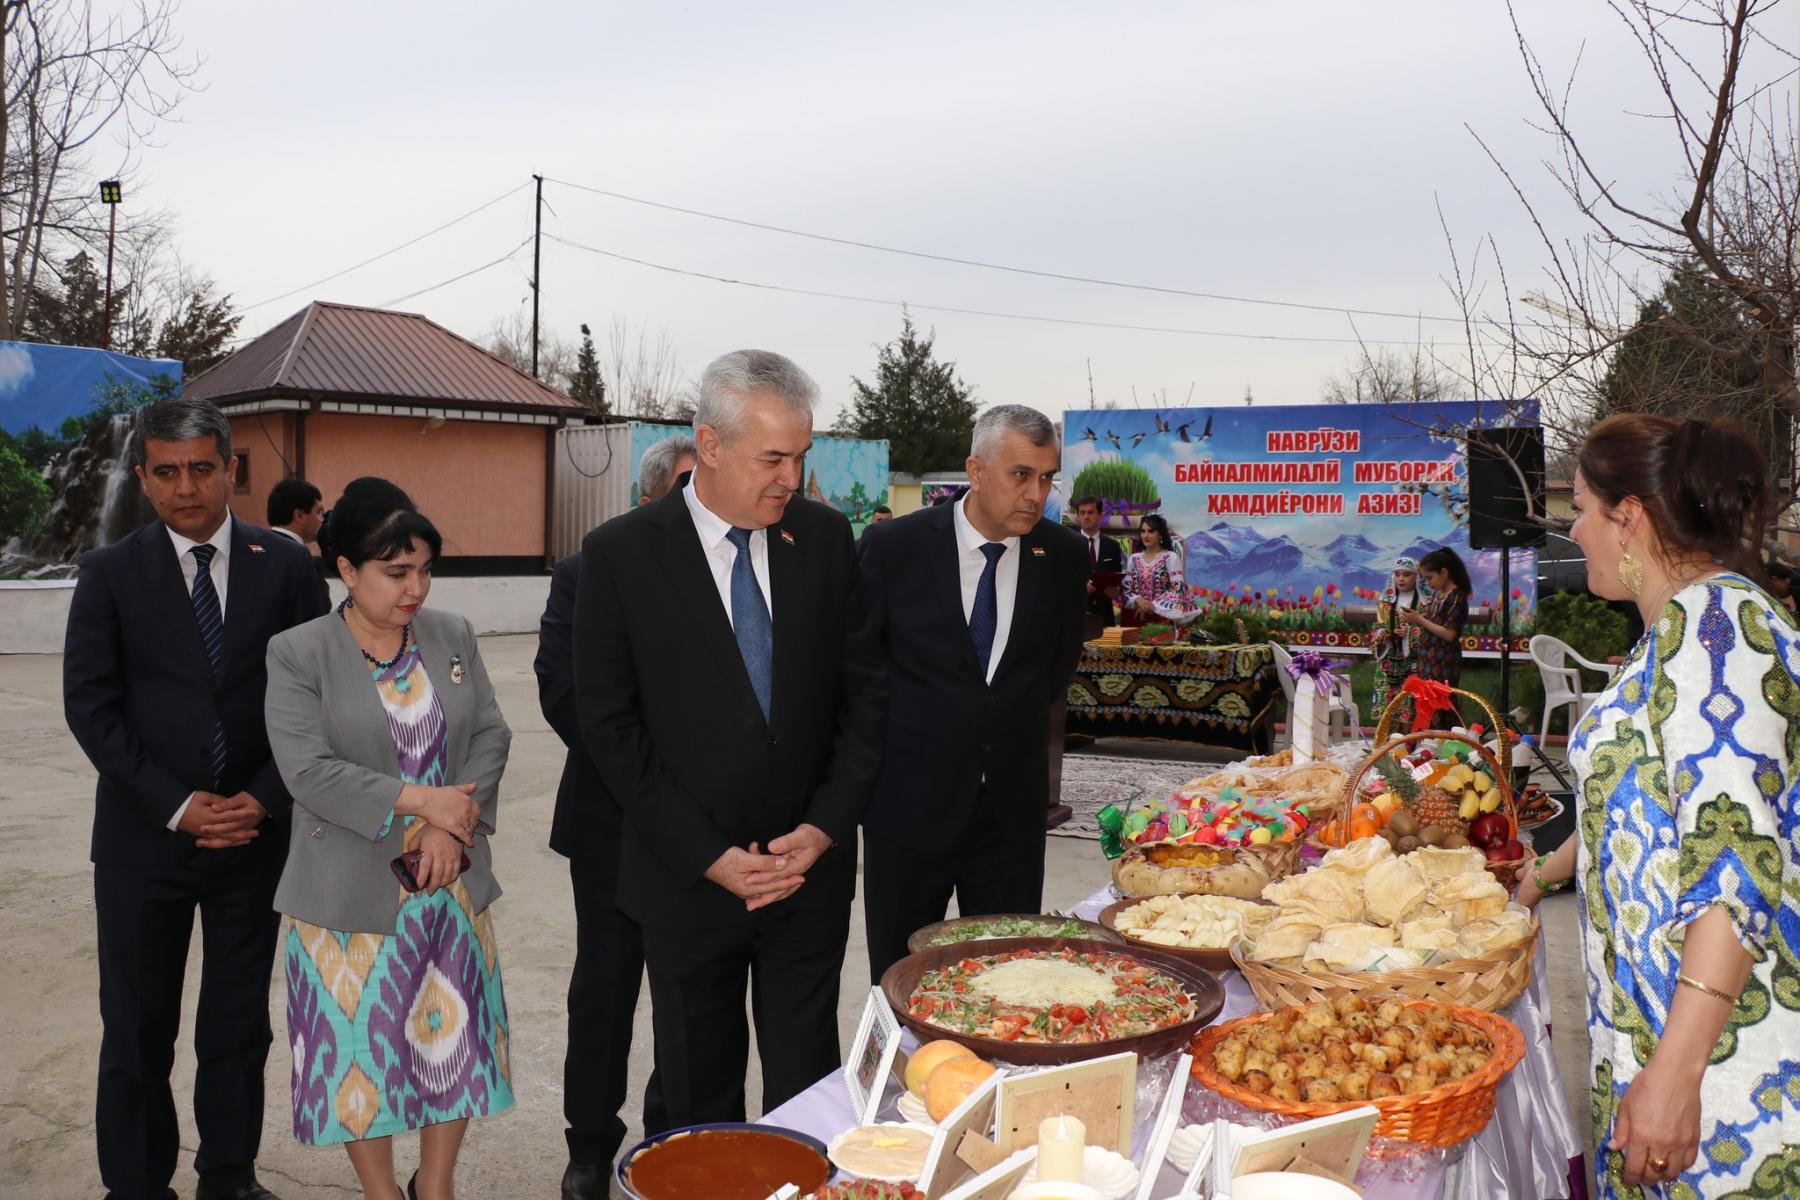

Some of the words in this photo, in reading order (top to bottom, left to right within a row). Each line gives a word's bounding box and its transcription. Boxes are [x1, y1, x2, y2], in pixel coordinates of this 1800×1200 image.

[1267, 428, 1360, 452] НАВРӮЗИ
[1174, 459, 1340, 483] БАЙНАЛМИЛАЛӢ
[1207, 490, 1343, 516] ҲАМДИЁРОНИ
[1357, 494, 1421, 514] АЗИЗ!
